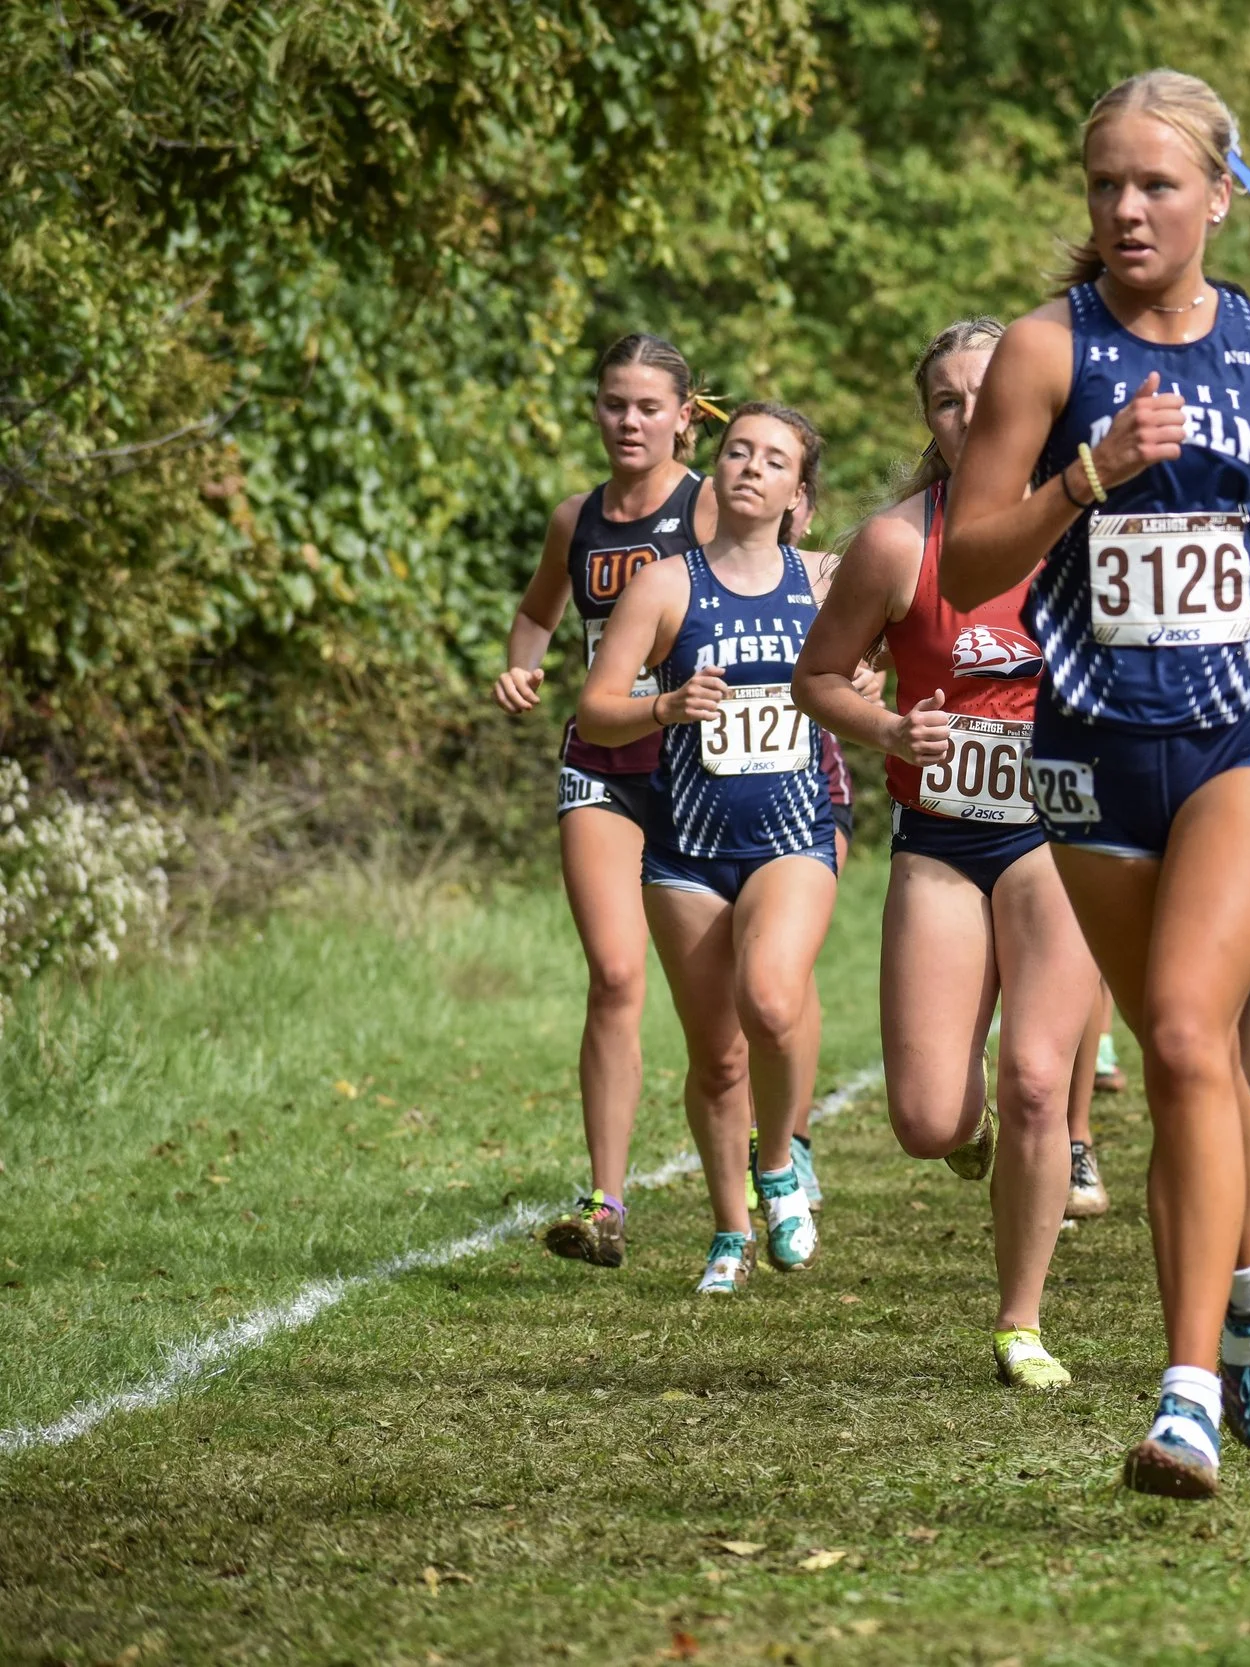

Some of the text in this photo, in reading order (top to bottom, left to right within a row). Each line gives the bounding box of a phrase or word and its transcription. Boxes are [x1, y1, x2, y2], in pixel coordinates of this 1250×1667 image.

[1113, 382, 1241, 409] SINT
[1097, 543, 1243, 617] 3126
[714, 618, 804, 637] SAINT
[1166, 628, 1201, 641] asics
[694, 634, 805, 672] ANSEL
[735, 688, 767, 700] LEHIGH
[706, 704, 804, 756] 3127
[968, 720, 1004, 734] LEHIGH
[752, 761, 776, 771] asics
[975, 807, 1005, 820] asics
